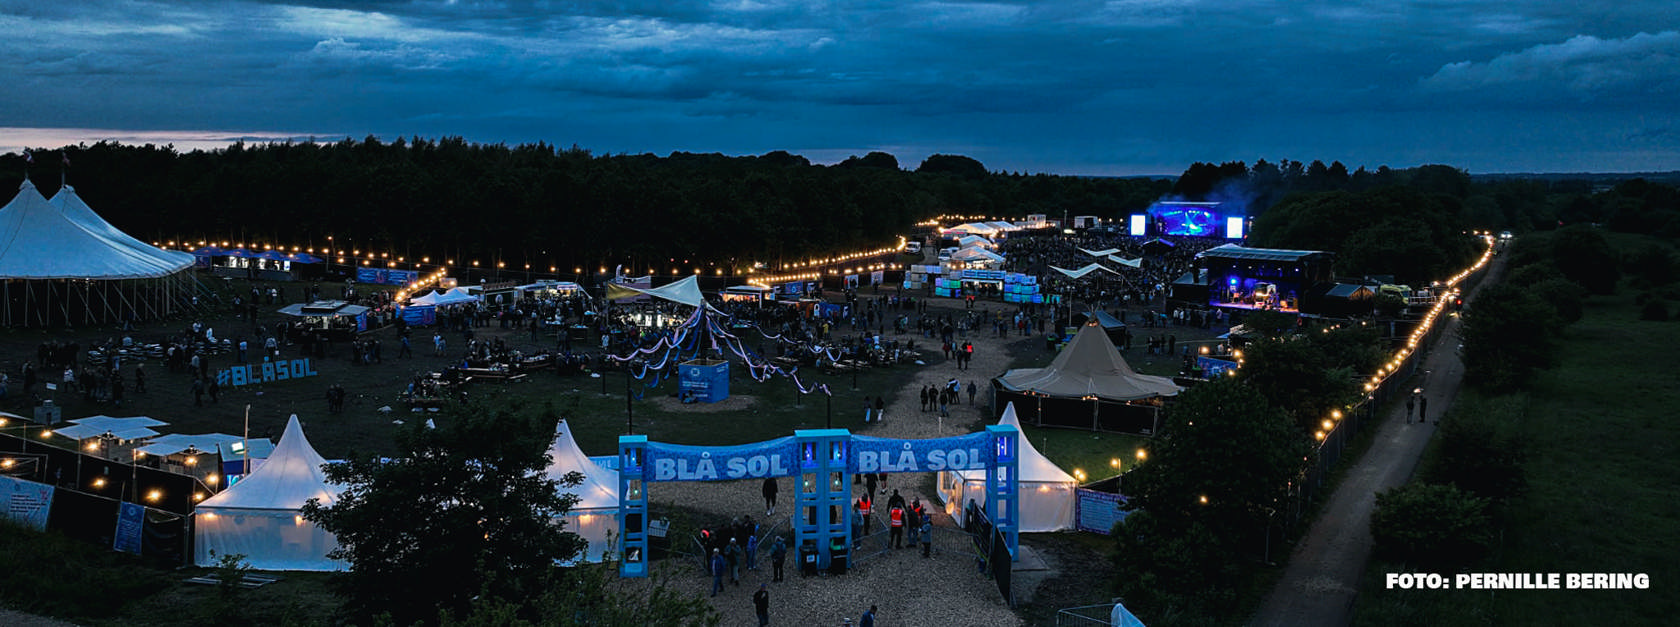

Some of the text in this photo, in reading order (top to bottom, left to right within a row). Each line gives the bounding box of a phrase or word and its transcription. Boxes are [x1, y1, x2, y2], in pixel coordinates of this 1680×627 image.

[217, 356, 318, 386] #BLÅSOL
[655, 451, 788, 480] BLÅ SOL
[859, 442, 985, 472] BLÅ SOL
